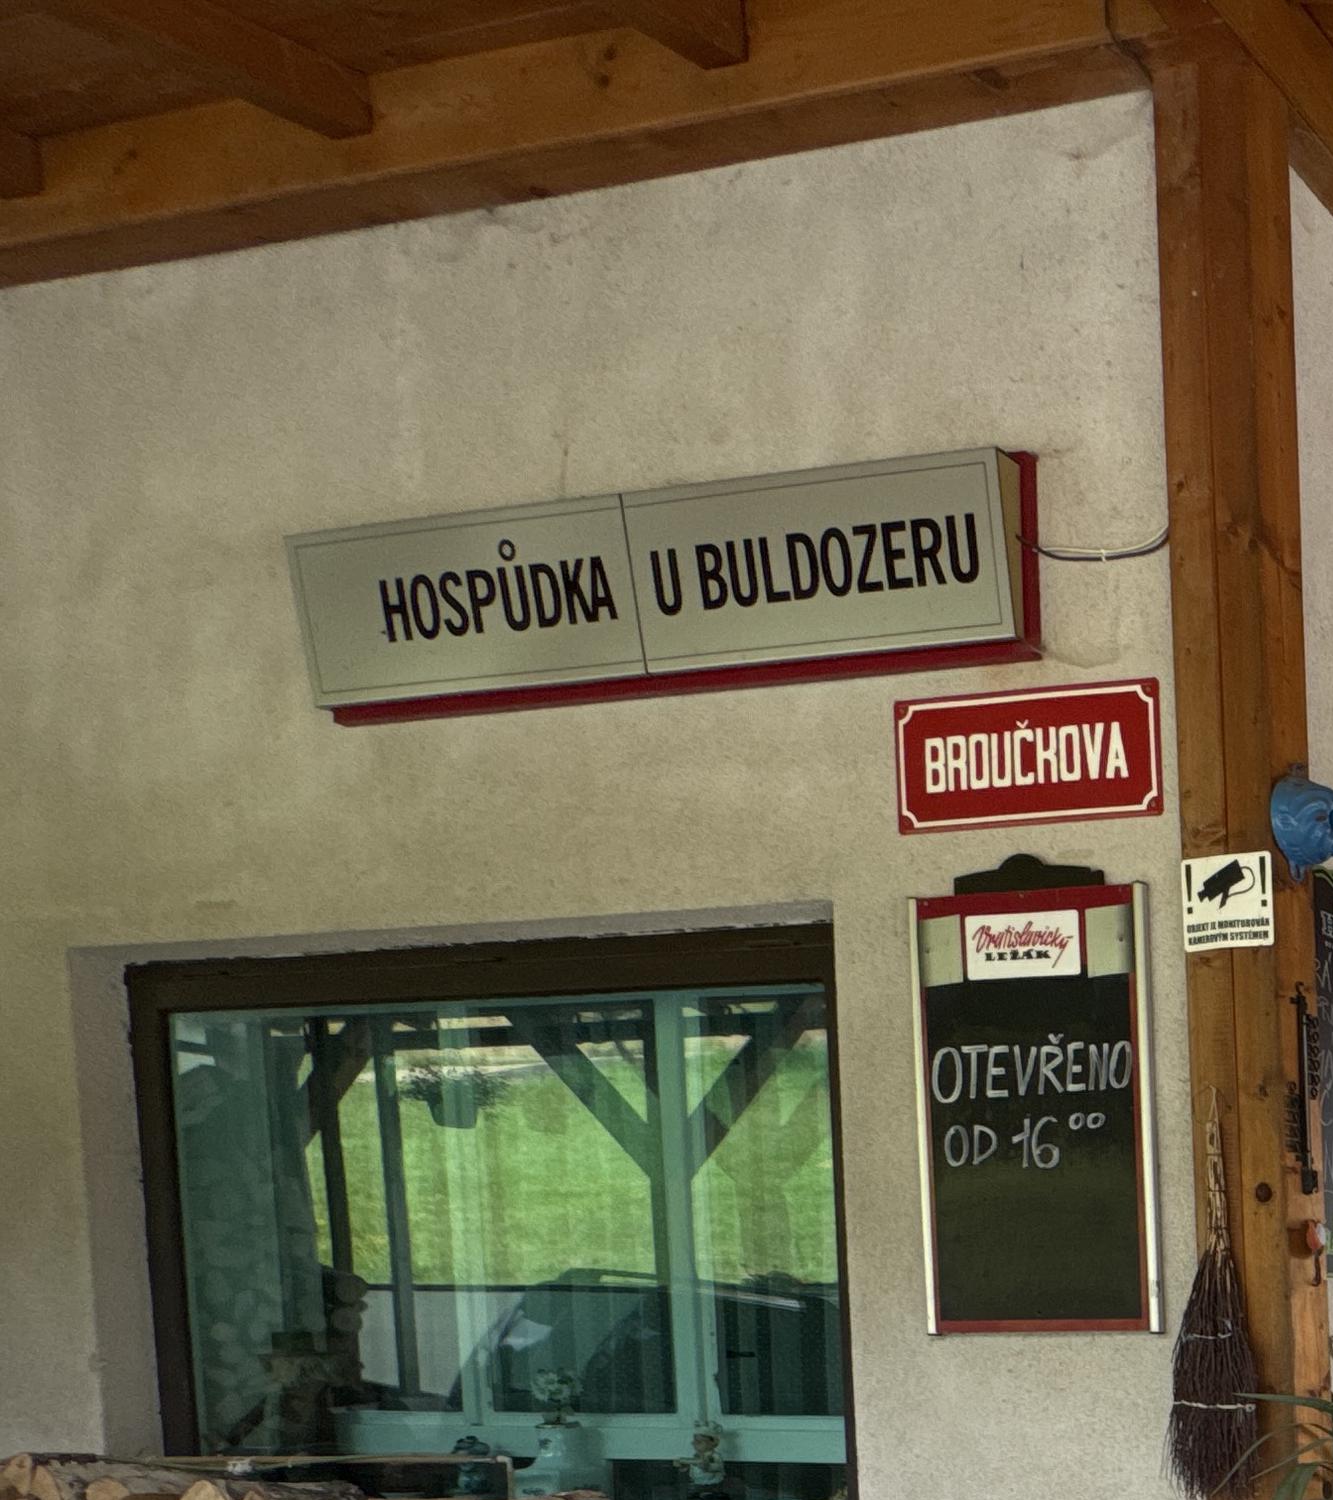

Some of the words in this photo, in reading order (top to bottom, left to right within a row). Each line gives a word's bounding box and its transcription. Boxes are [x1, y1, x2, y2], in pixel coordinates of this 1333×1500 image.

[378, 538, 619, 643] HOSPŮDKA
[650, 548, 682, 616] U
[694, 512, 980, 610] BULDOZERU
[924, 719, 1130, 794] BROUČKOVA
[972, 920, 1075, 969] Vratislavický
[984, 948, 1052, 962] LEŽÁK
[1229, 930, 1269, 941] SYSTÉMEM
[931, 1033, 1133, 1104] OTEVŘENO
[944, 1124, 998, 1168] OD
